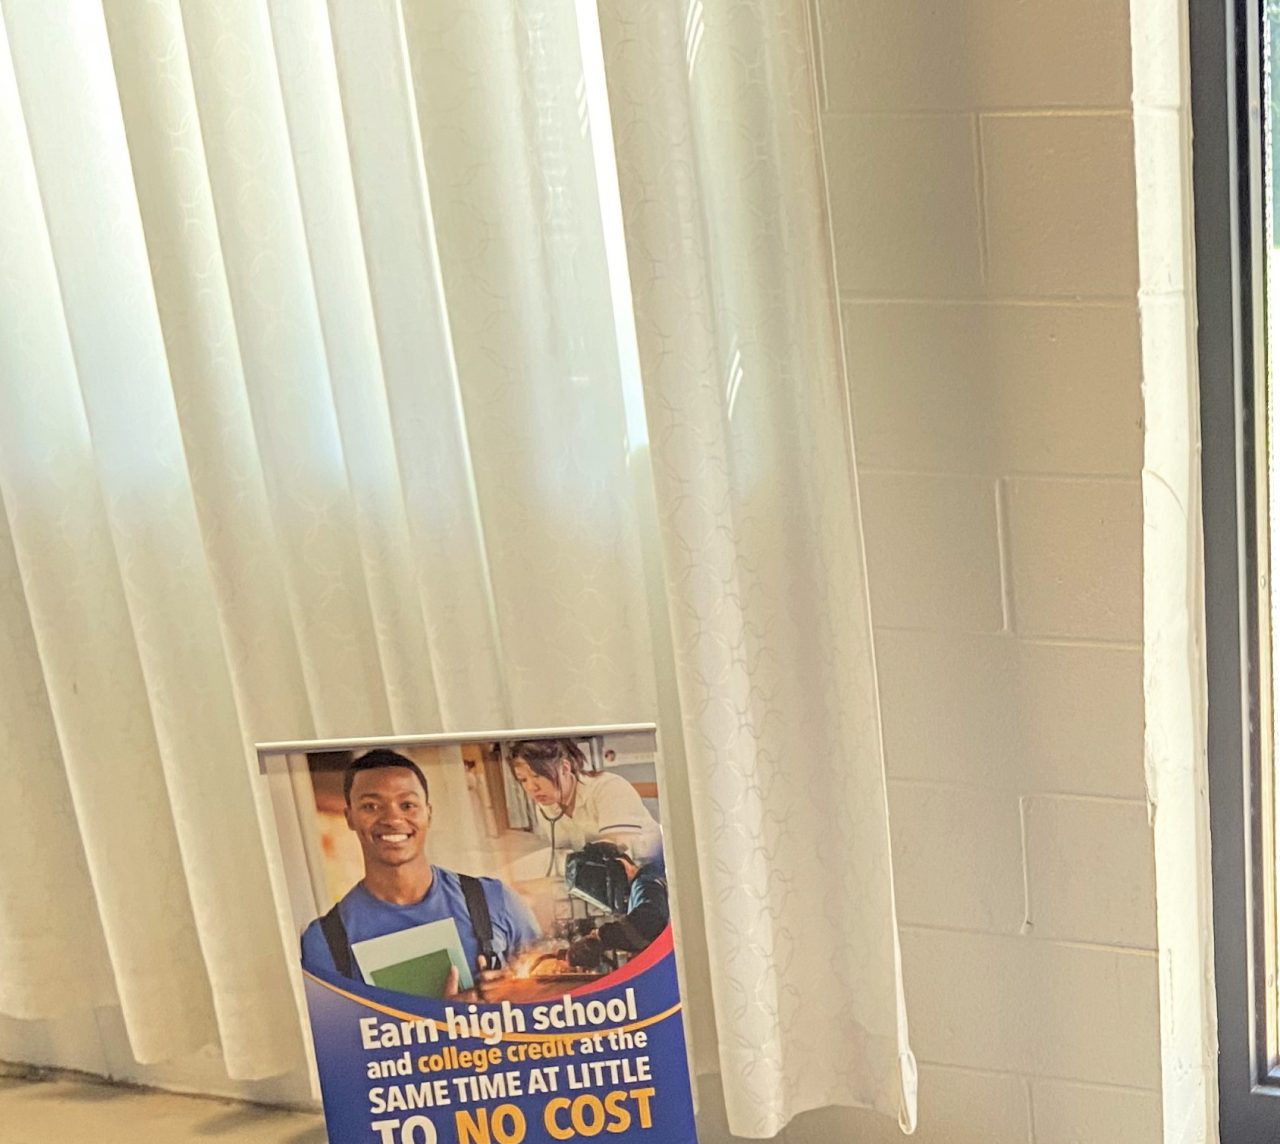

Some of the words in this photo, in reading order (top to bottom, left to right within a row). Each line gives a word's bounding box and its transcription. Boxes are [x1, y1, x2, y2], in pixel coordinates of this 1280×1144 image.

[360, 1017, 438, 1049] Earn
[445, 1001, 525, 1045] high
[533, 988, 637, 1031] school
[367, 1052, 412, 1079] and
[418, 1046, 502, 1072] college
[507, 1039, 574, 1061] credit
[580, 1036, 603, 1054] at
[608, 1029, 648, 1050] the
[368, 1080, 450, 1114] SAME
[453, 1071, 523, 1103] TIME
[528, 1066, 560, 1094] AT
[567, 1056, 651, 1089] LITTLE
[544, 1088, 656, 1140] COST
